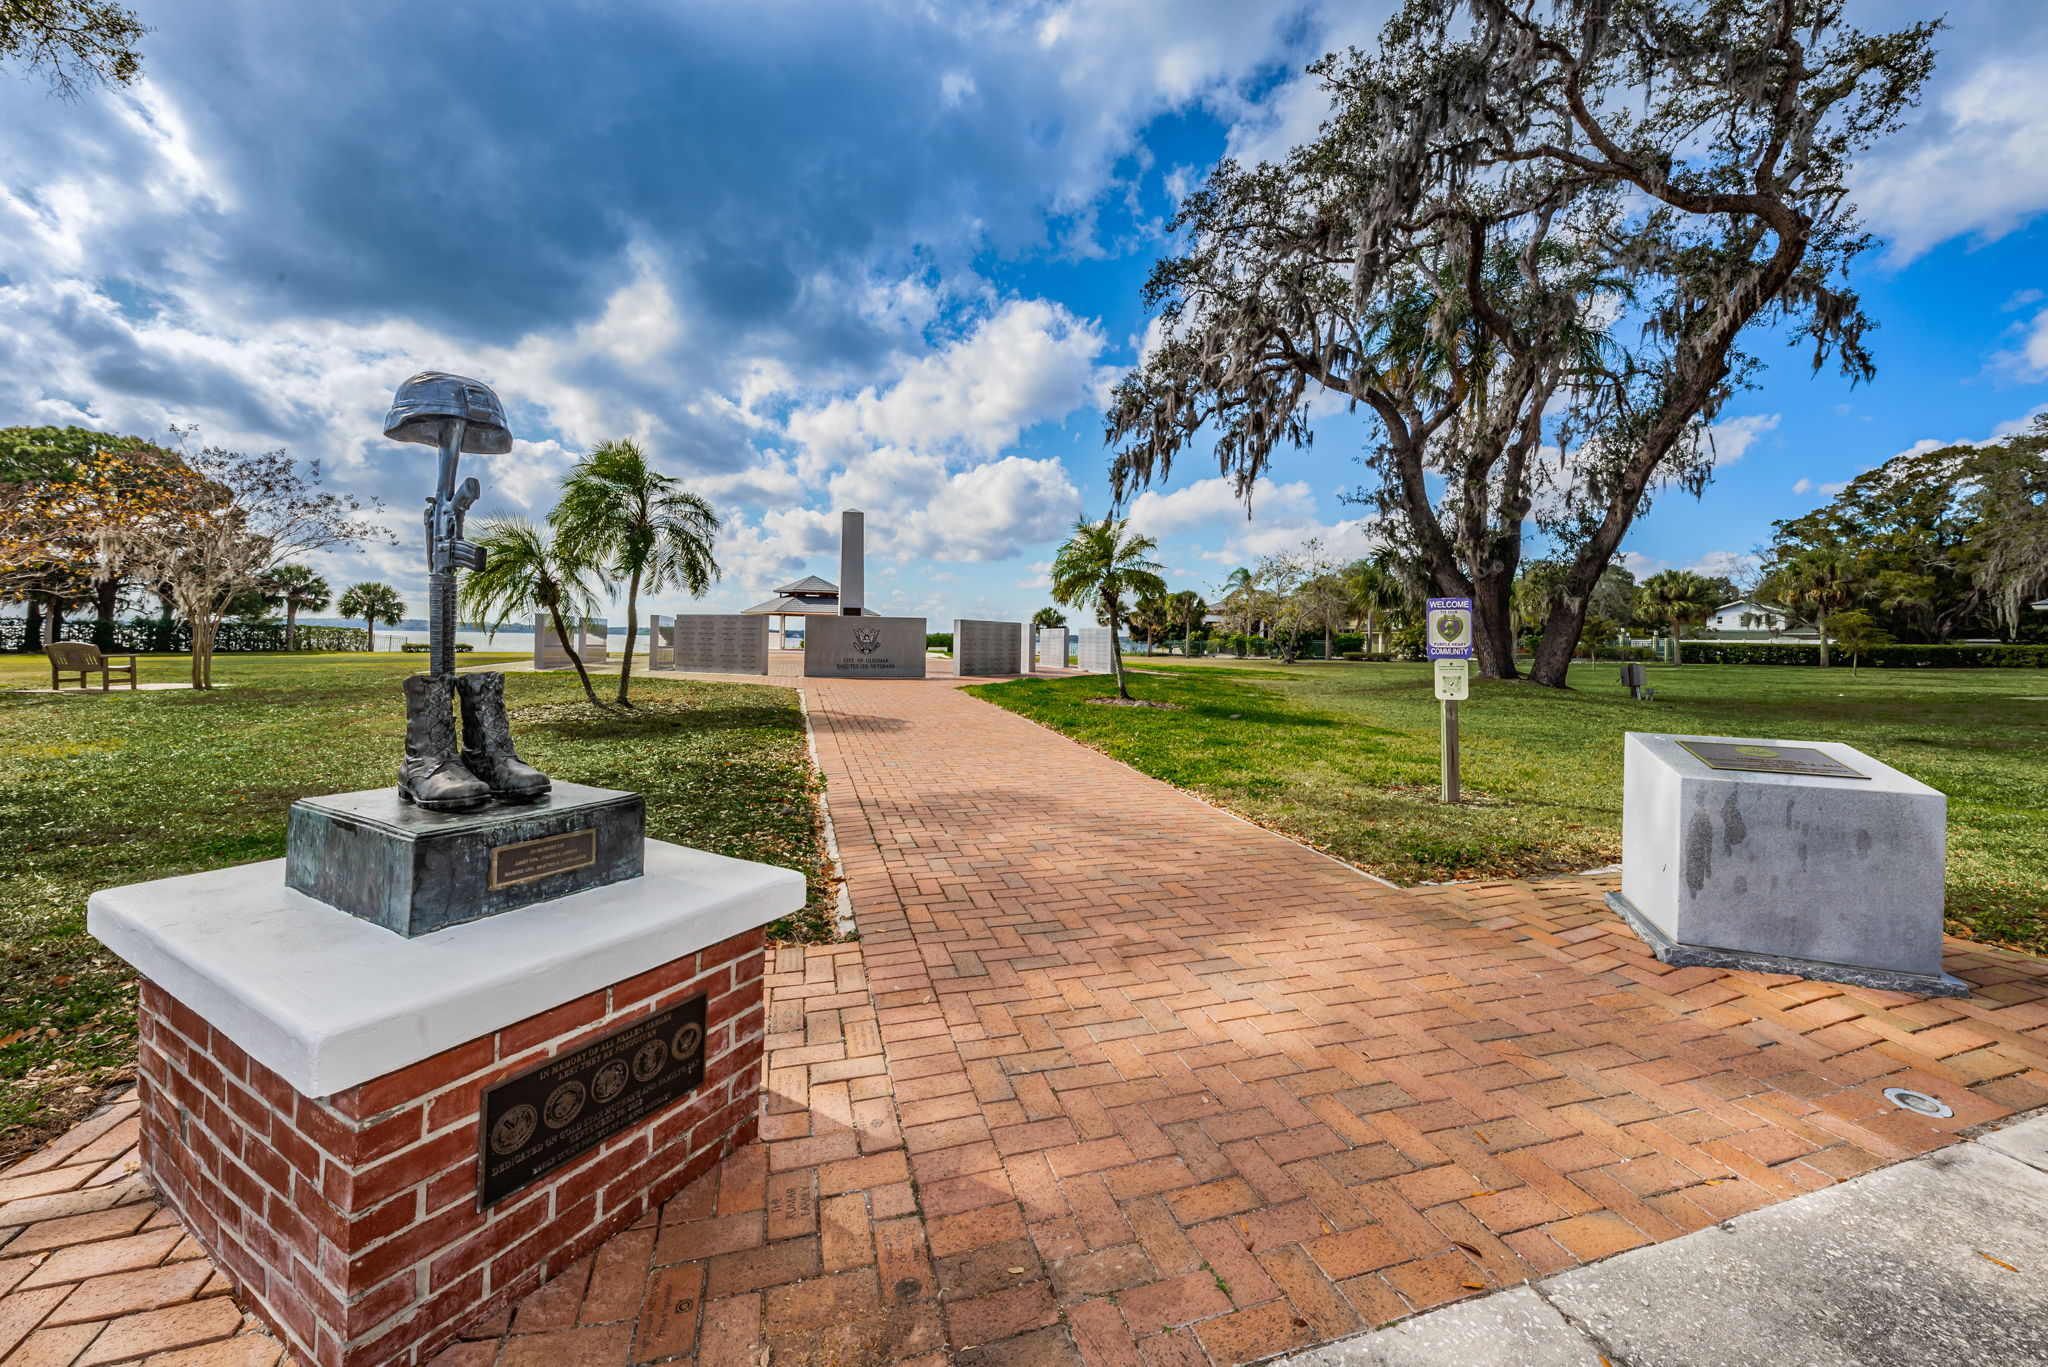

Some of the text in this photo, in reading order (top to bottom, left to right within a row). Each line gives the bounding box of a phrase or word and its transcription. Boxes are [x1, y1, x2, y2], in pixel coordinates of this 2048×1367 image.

[541, 1071, 550, 1080] IN
[552, 1054, 586, 1074] MEMORY
[589, 1048, 599, 1057] OF
[601, 1041, 615, 1052] ALL
[617, 1027, 643, 1044] FALLEN
[559, 1066, 578, 1080] LEST
[581, 1056, 601, 1070] THEY
[493, 1143, 544, 1177] DEDICATED
[546, 1136, 558, 1148] ON
[560, 1123, 582, 1140] GOLD
[584, 1111, 604, 1127] STAR
[571, 1114, 616, 1144] SEPTEMBER
[771, 1197, 782, 1215] THE
[800, 1185, 811, 1217] FAMILY
